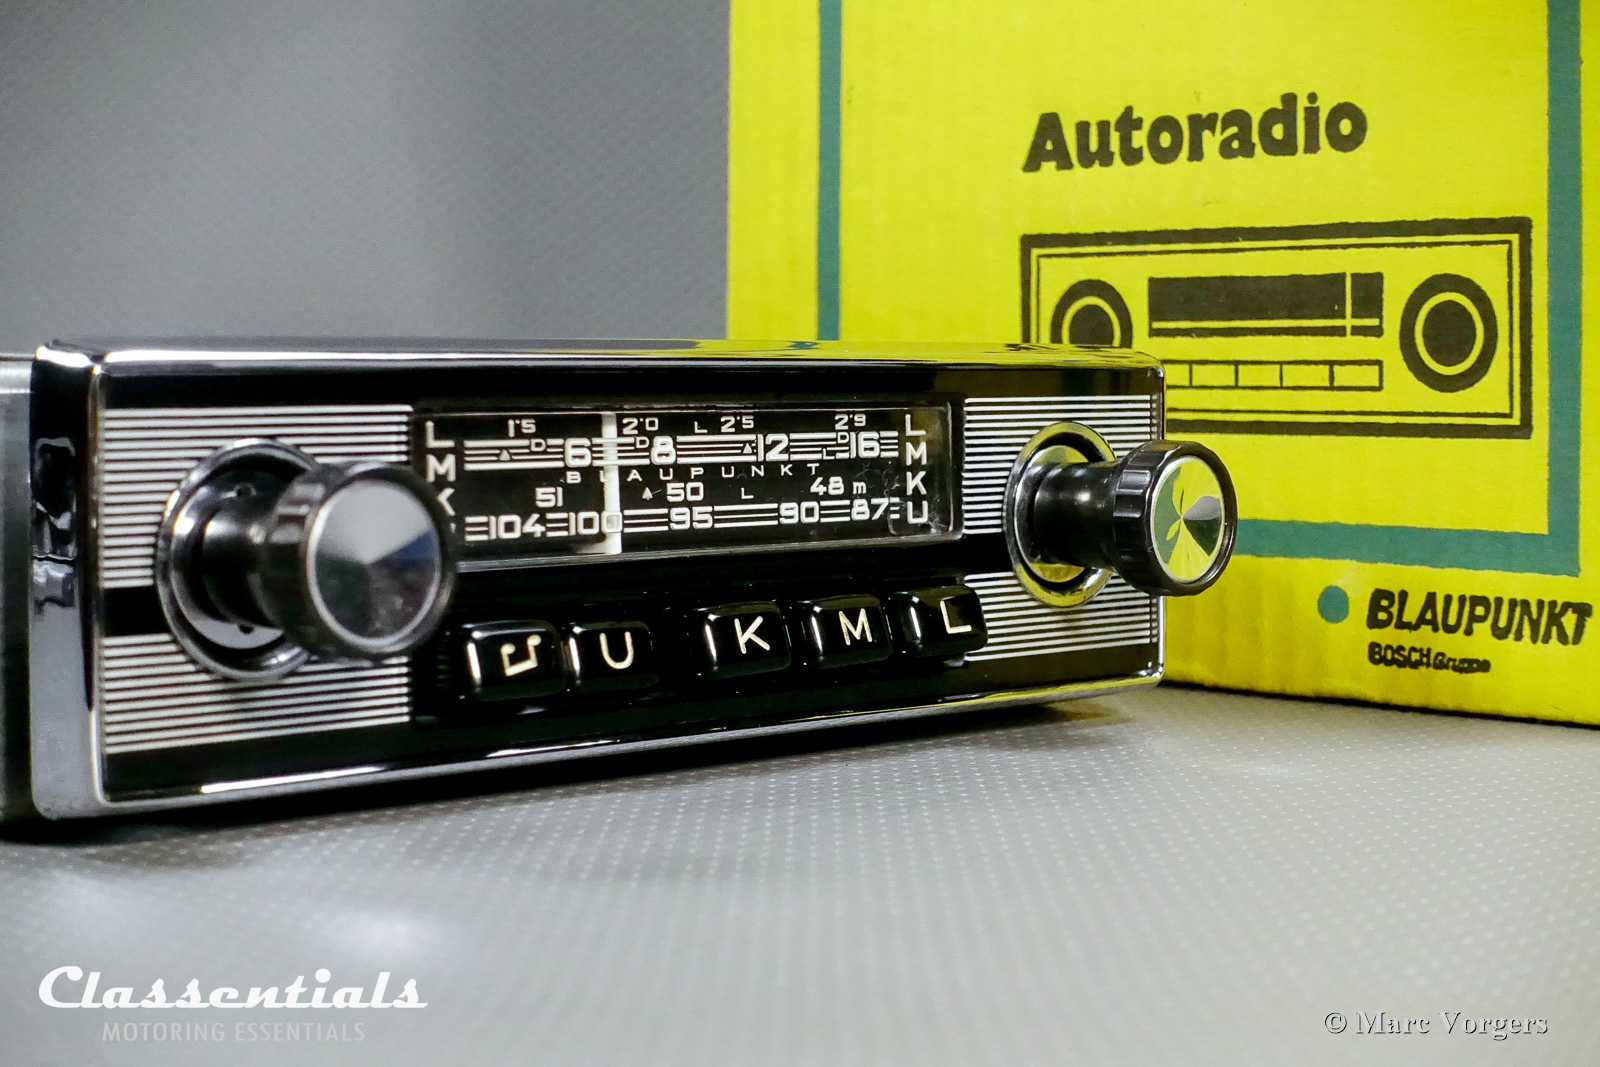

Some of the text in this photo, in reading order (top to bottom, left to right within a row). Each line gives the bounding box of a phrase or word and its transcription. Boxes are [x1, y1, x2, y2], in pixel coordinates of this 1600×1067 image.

[1022, 92, 1368, 173] Autoradio
[425, 420, 455, 448] L
[904, 413, 926, 437] L
[564, 437, 592, 468] 6
[651, 435, 676, 466] 8
[757, 433, 790, 462] 12
[849, 431, 880, 459] 16
[905, 441, 928, 466] M
[426, 453, 456, 483] M
[666, 481, 704, 503] 50
[810, 476, 845, 496] 48
[906, 471, 927, 496] K
[488, 498, 890, 541] 104 100 95 90 87
[906, 500, 928, 525] U
[1366, 587, 1594, 646] BLAUPUNKT
[600, 600, 972, 670] U K M L
[1368, 641, 1431, 670] BOSCH
